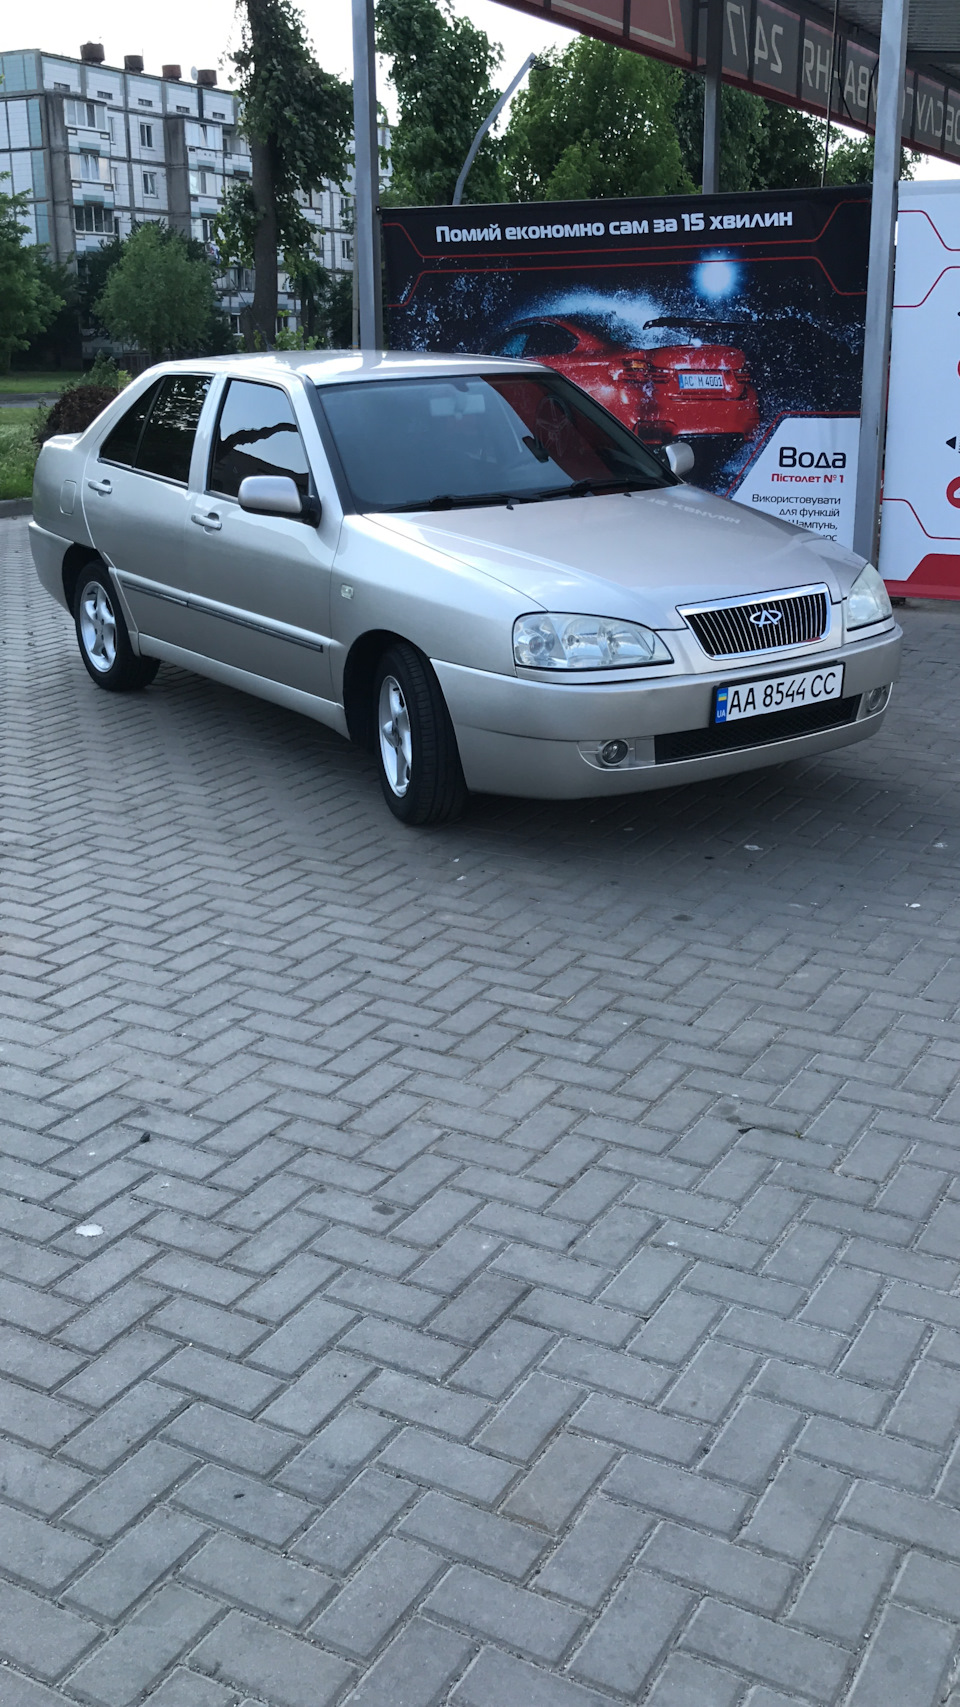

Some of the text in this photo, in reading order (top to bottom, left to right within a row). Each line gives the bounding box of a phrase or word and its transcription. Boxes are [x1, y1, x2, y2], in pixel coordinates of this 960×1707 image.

[435, 211, 793, 243] Помий економно сам за 15 хвилин
[778, 446, 847, 469] Вода
[770, 473, 822, 483] Пістолет
[839, 474, 844, 483] 1
[751, 493, 841, 506] Використовувати
[778, 507, 840, 518] для функцій
[728, 672, 837, 715] AA 8544 CC
[716, 709, 727, 719] UA
